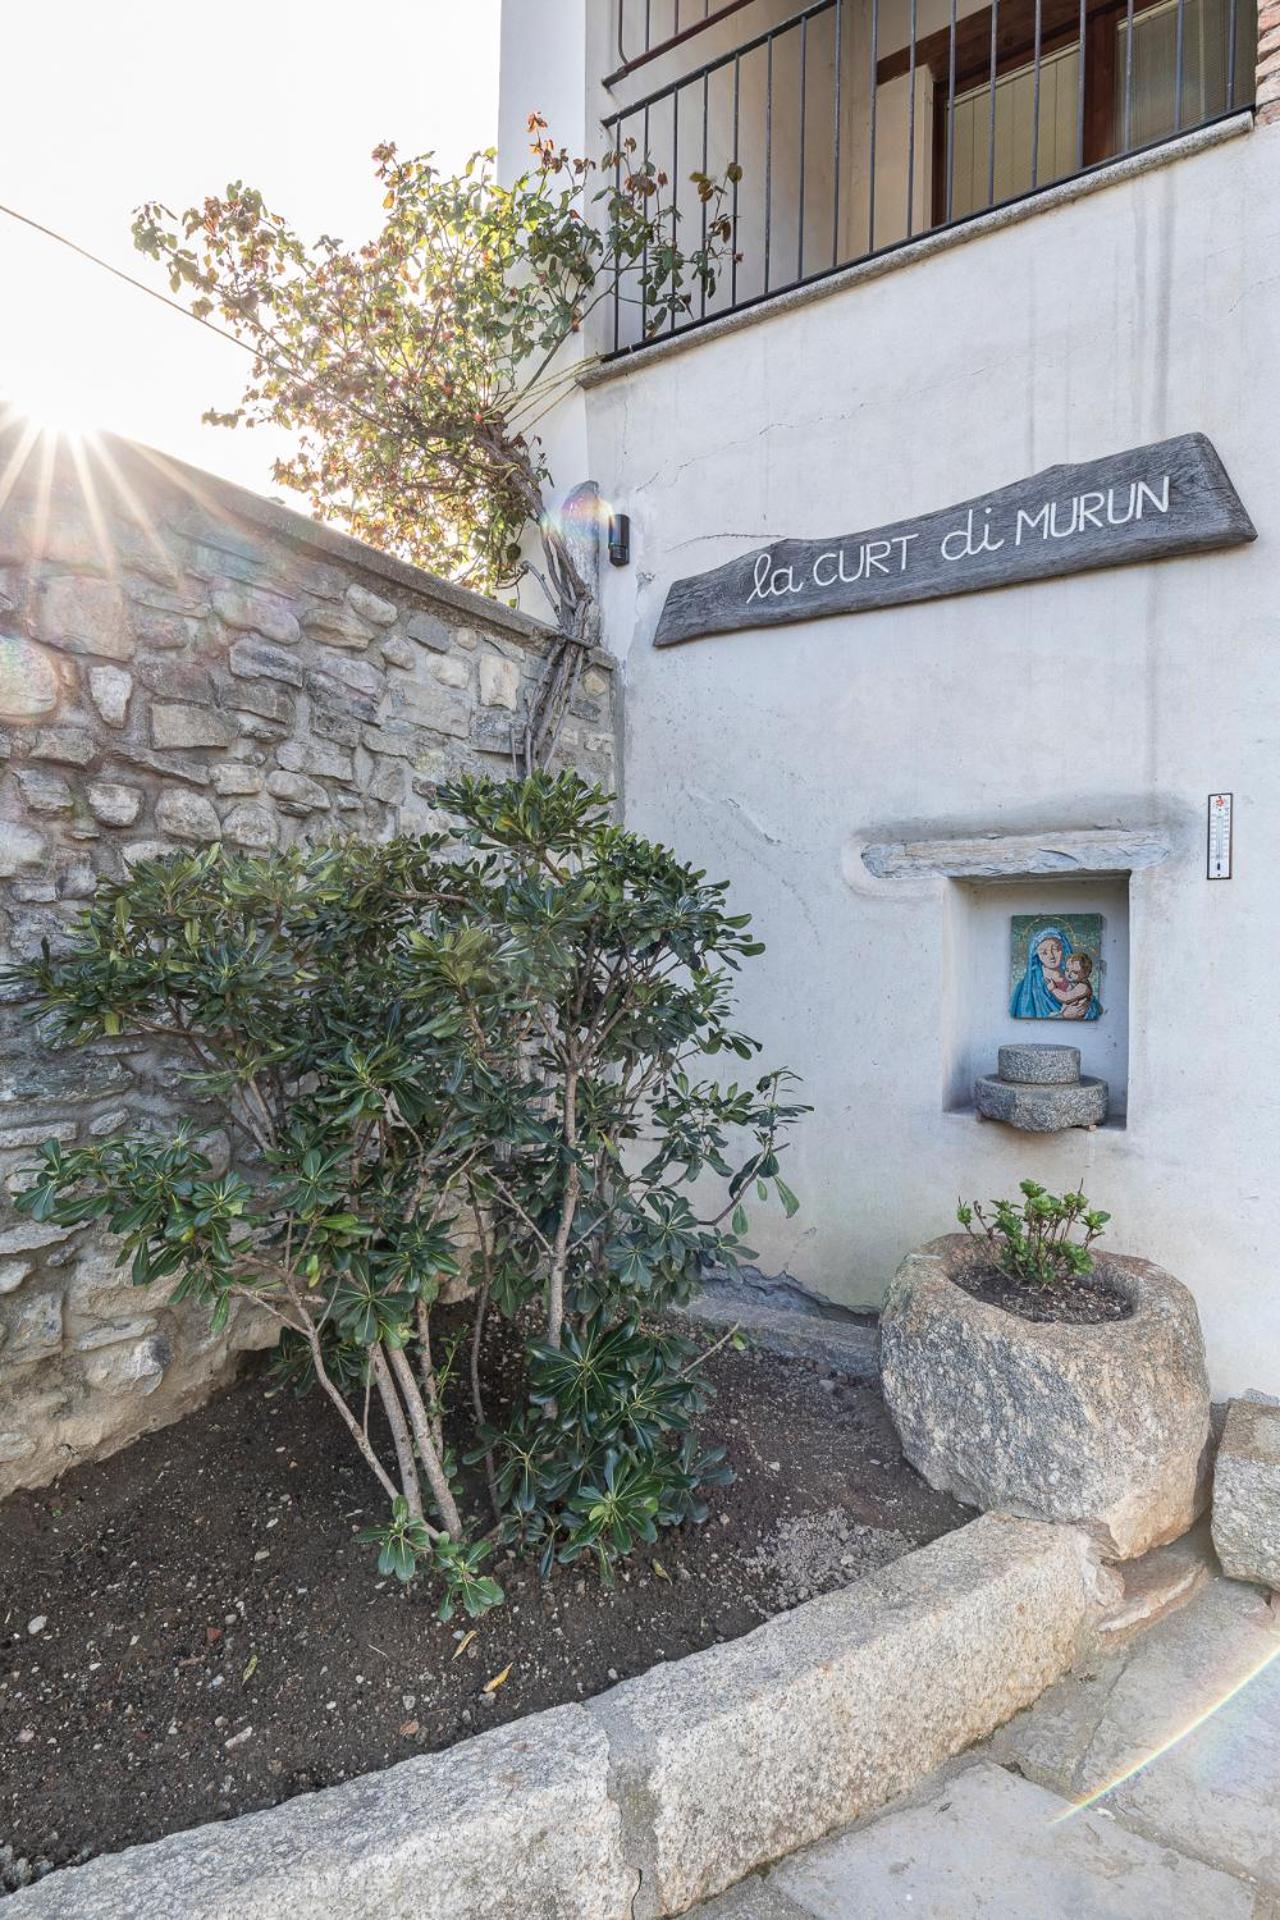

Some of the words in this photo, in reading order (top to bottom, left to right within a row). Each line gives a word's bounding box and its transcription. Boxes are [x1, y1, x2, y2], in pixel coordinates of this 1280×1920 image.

[746, 554, 803, 603] la
[812, 534, 918, 586] CURT
[941, 509, 1004, 561] di
[1015, 476, 1170, 546] MURUN
